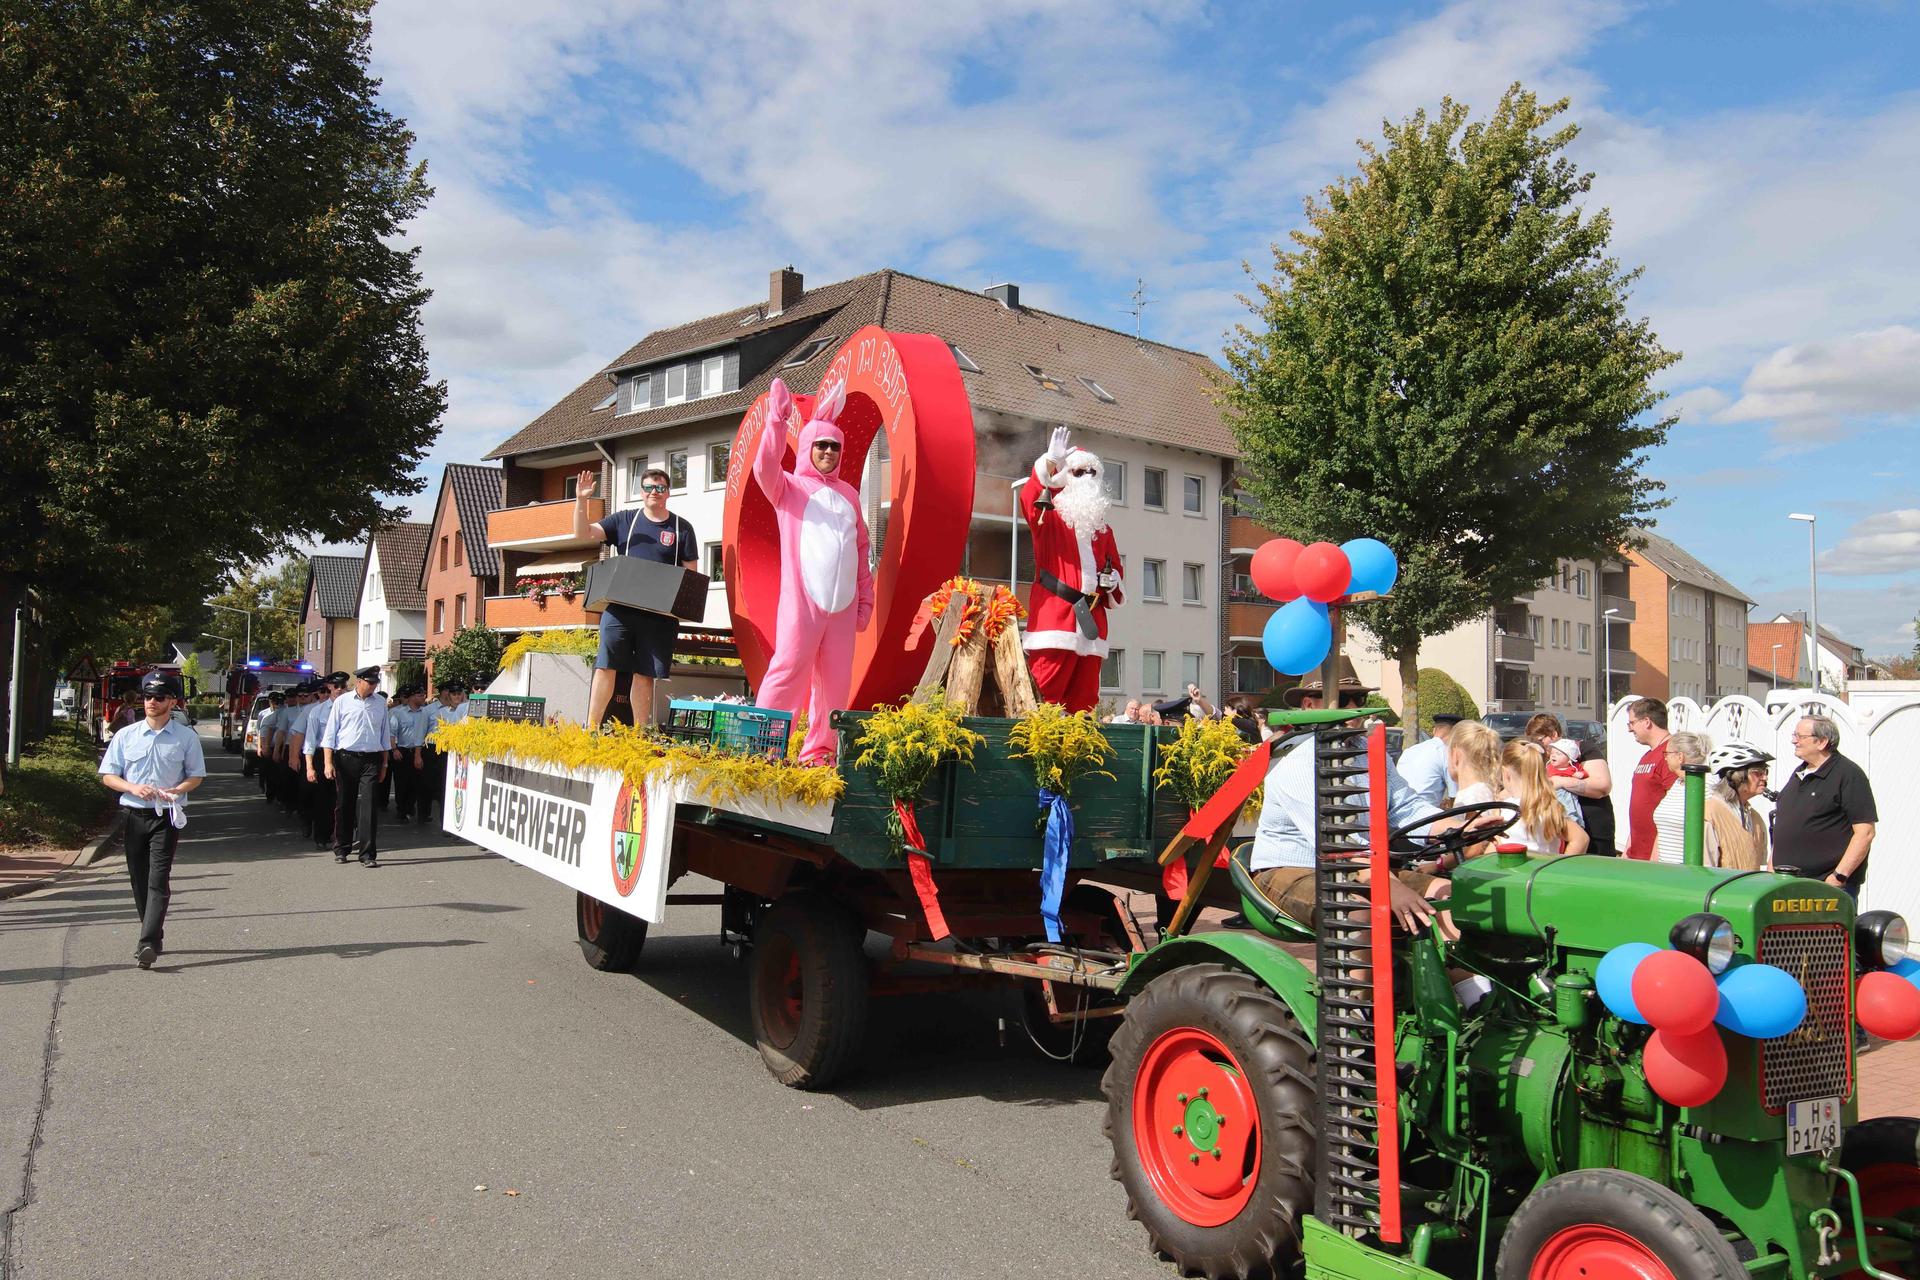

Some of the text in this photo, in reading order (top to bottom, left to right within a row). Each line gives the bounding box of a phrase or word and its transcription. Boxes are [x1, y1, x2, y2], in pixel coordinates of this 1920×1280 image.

[478, 780, 587, 868] FEUERWEHR
[1772, 898, 1839, 912] DEUTZ
[1811, 1102, 1820, 1124] H
